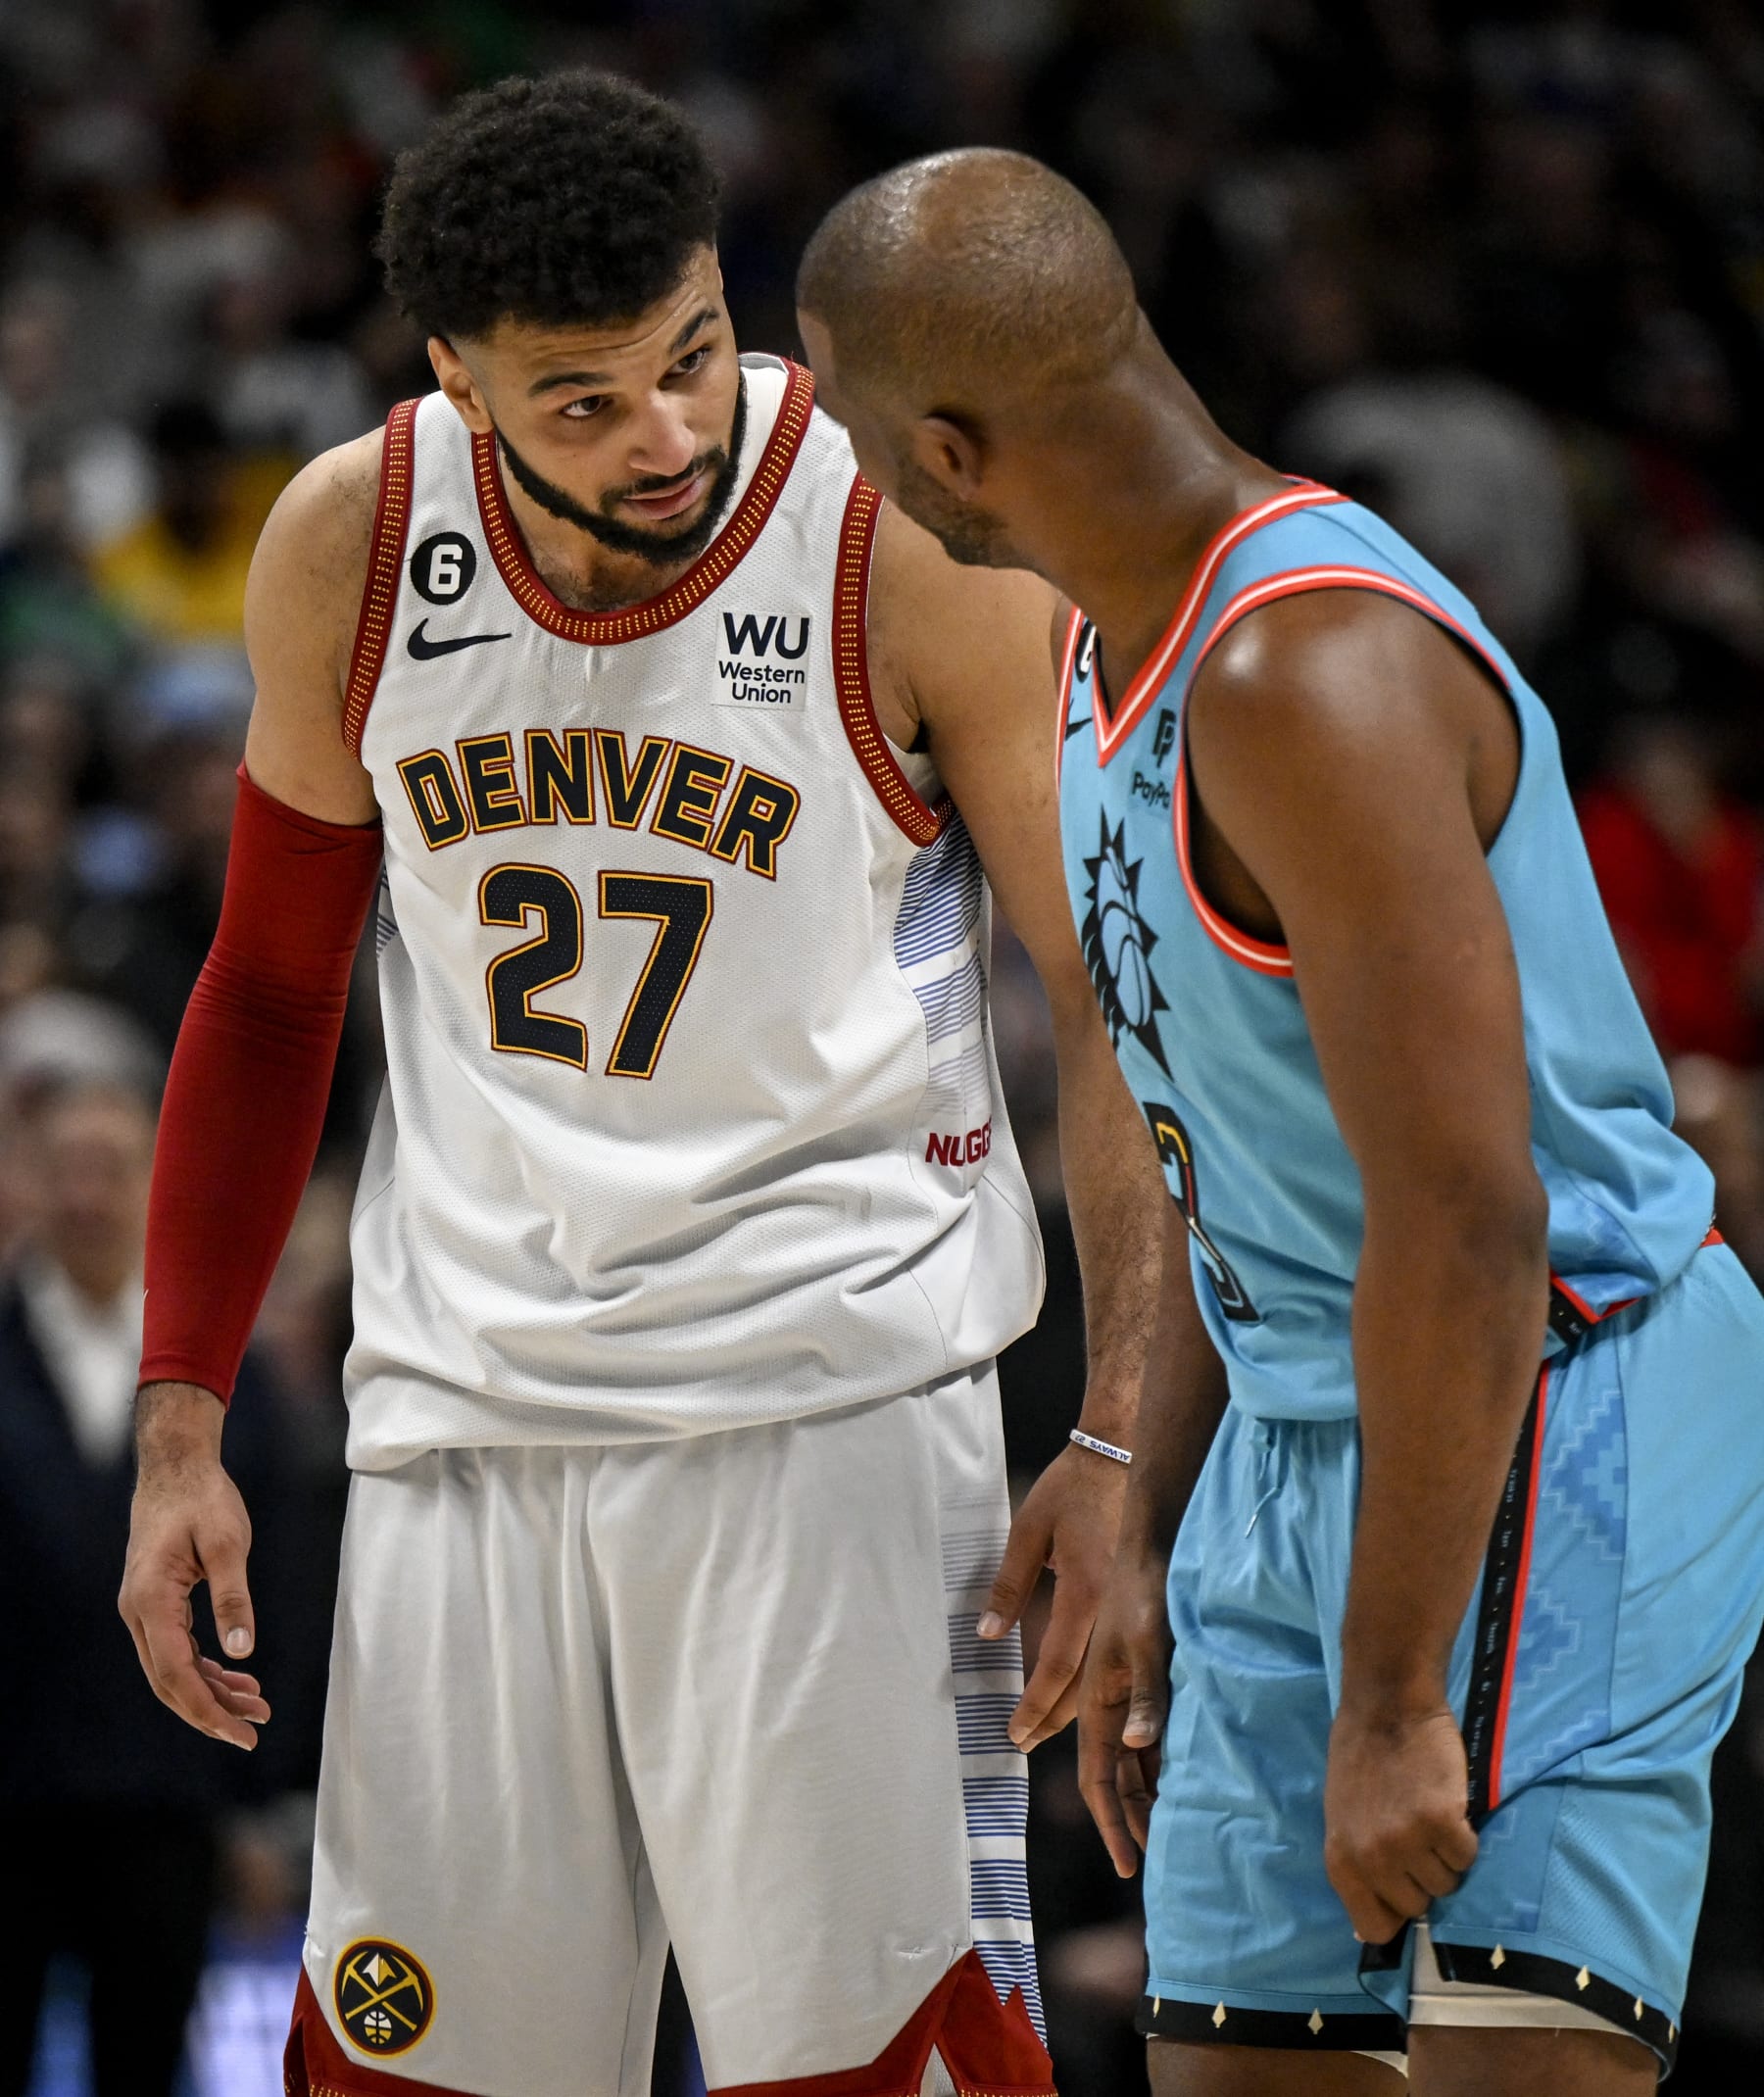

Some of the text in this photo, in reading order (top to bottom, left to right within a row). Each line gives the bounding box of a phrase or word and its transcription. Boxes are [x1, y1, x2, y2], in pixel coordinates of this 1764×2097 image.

[427, 543, 463, 595] 6
[722, 611, 809, 659] WU
[718, 659, 806, 684] Western
[731, 682, 792, 704] Union
[396, 728, 801, 882] DENVER
[1132, 770, 1171, 809] PayPa
[477, 861, 714, 1080] 27
[924, 1115, 992, 1167] NUGG
[1143, 1100, 1261, 1323] 3
[1089, 1440, 1130, 1461] ALWAYS
